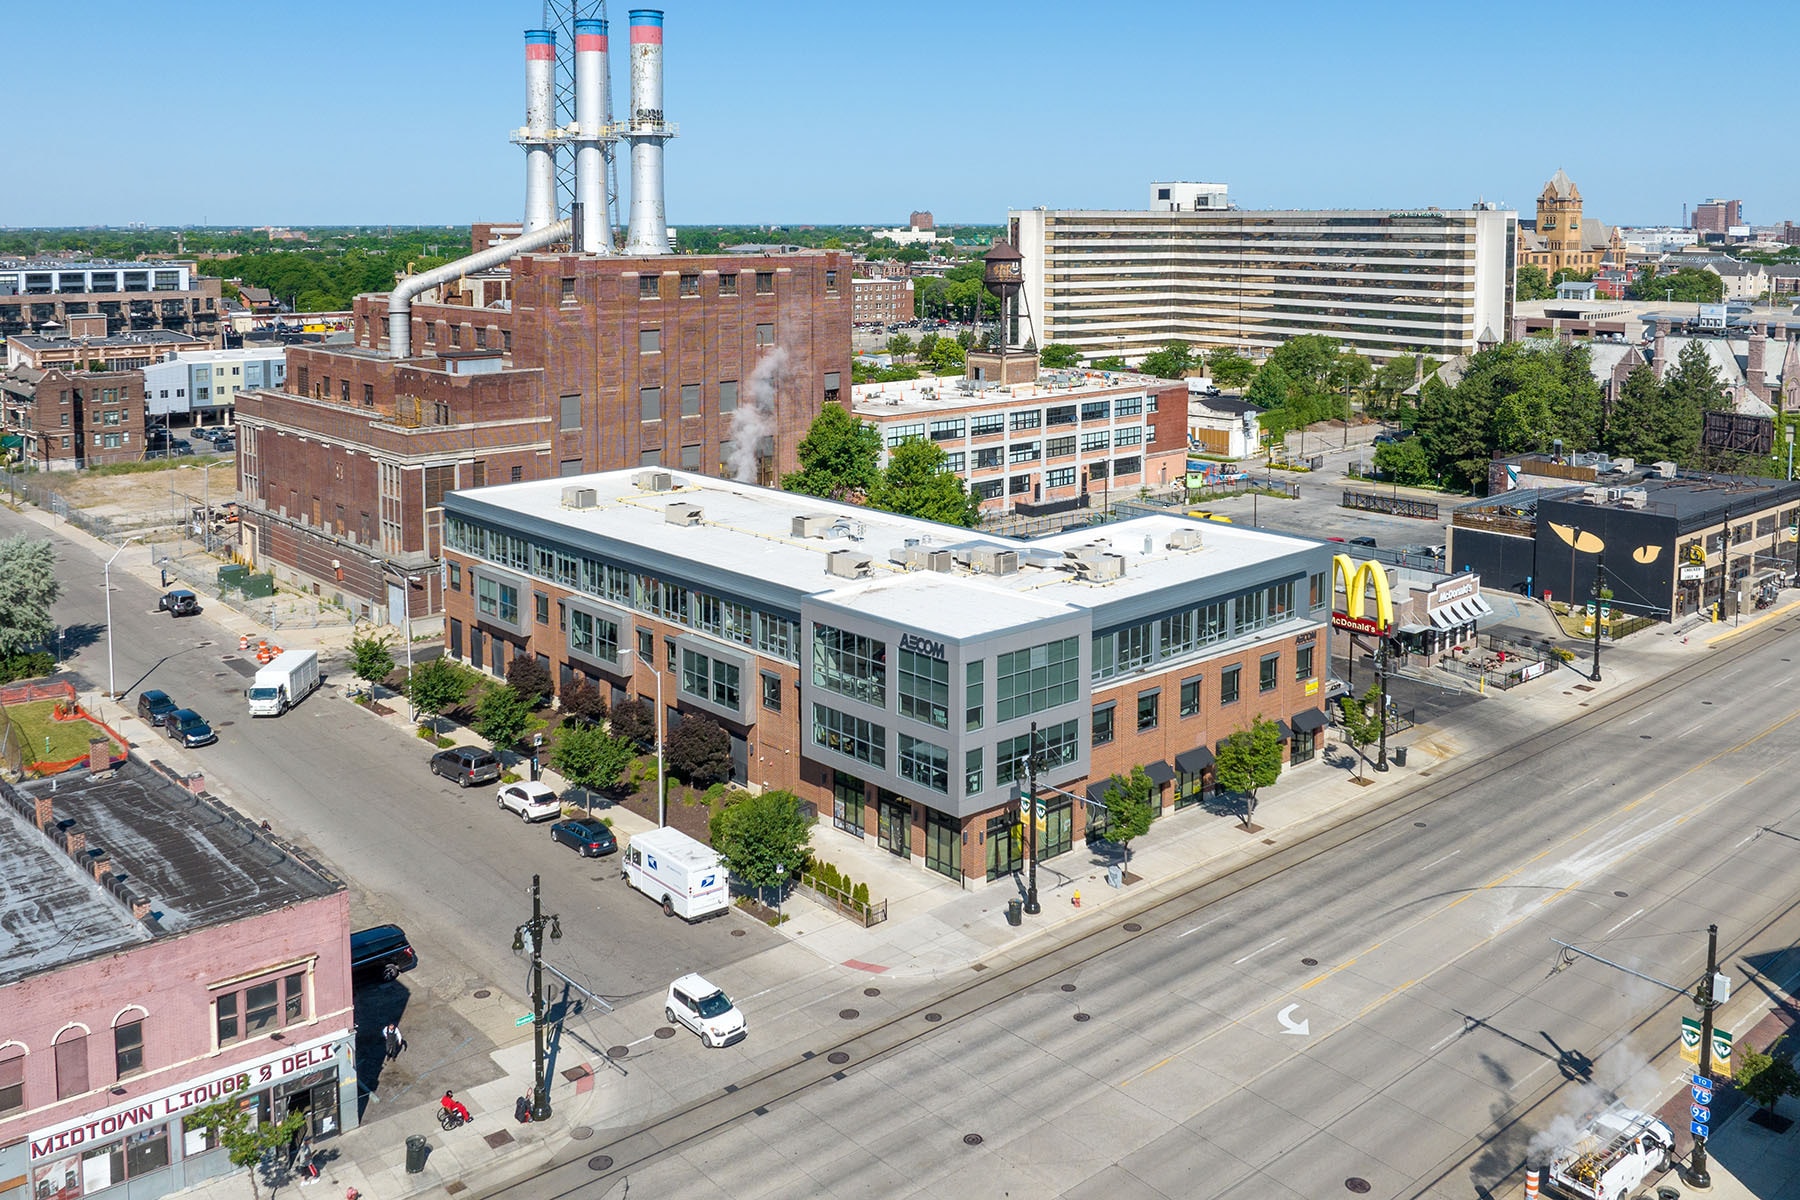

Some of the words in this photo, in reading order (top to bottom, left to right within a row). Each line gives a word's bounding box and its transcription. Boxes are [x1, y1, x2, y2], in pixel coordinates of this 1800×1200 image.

[1438, 584, 1473, 603] McDonald's
[900, 633, 945, 659] AECOM
[1697, 1077, 1707, 1086] TO
[31, 1104, 153, 1160] MIDTOWN
[282, 1043, 333, 1075] DELI
[1694, 1088, 1709, 1103] 75
[1692, 1107, 1707, 1121] 94
